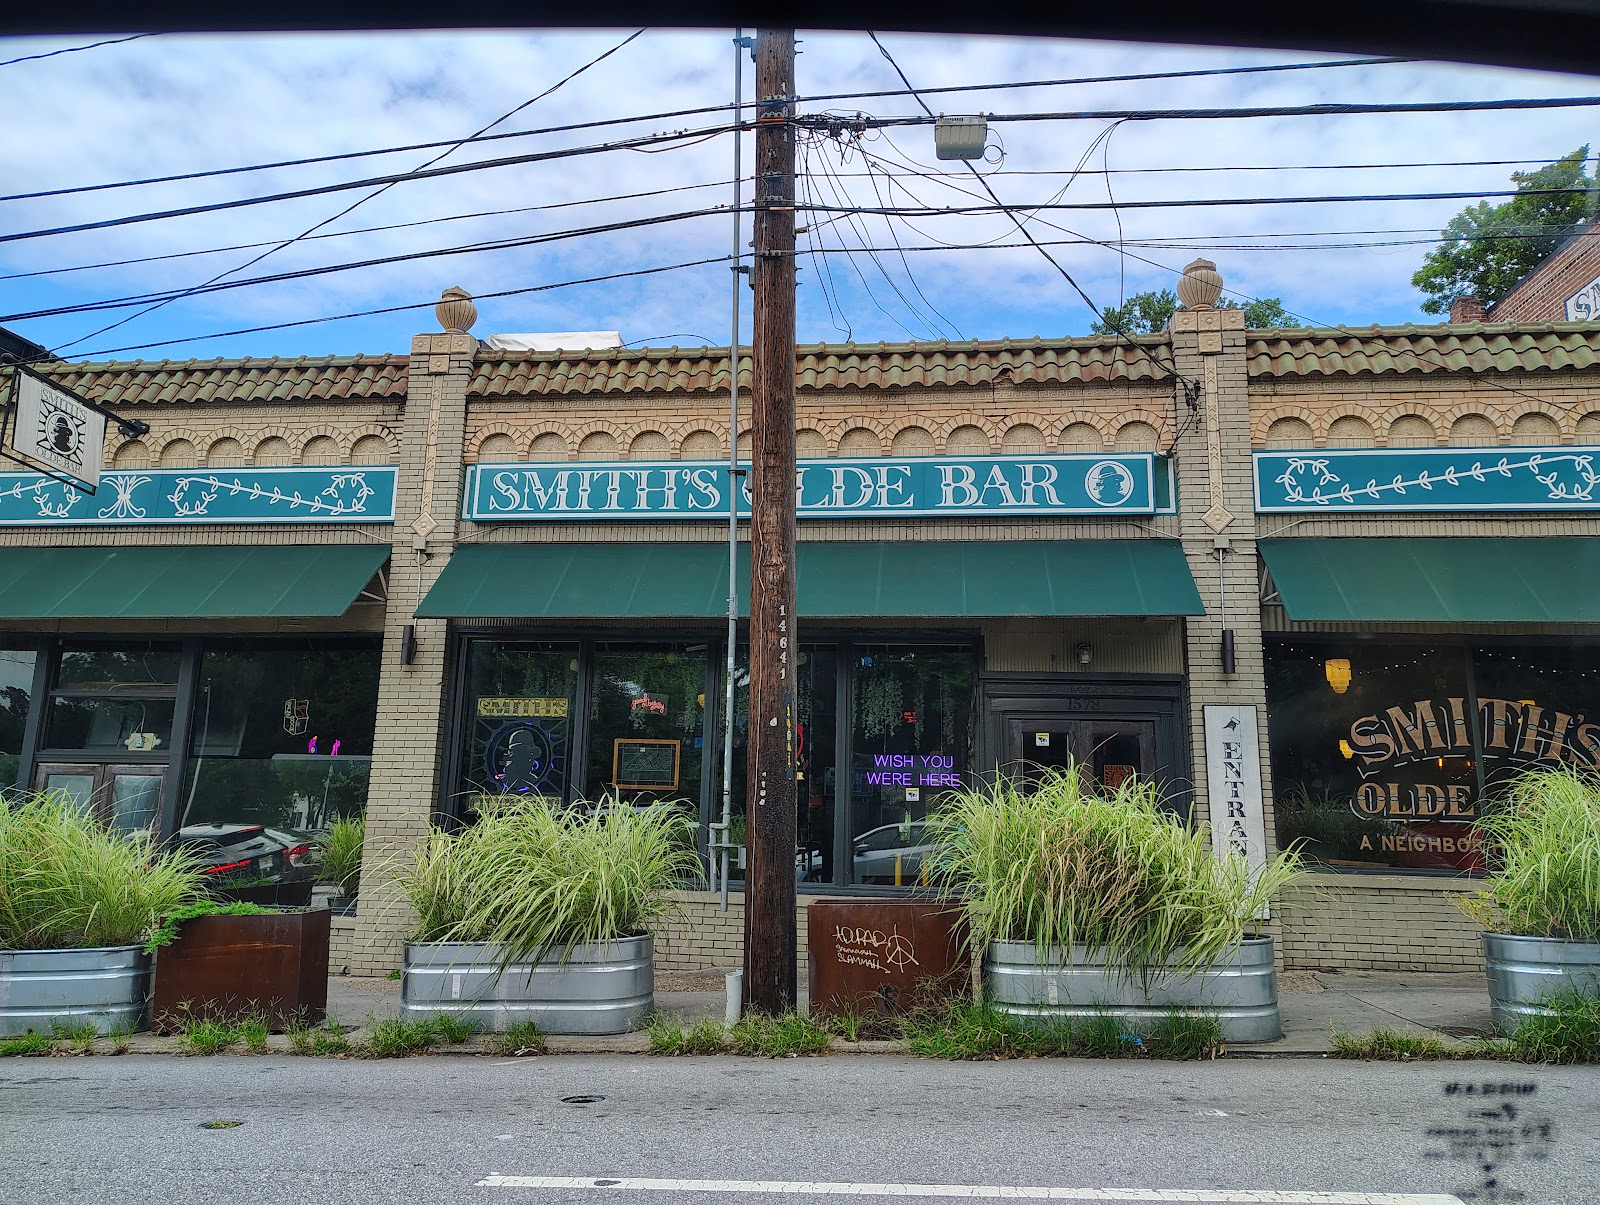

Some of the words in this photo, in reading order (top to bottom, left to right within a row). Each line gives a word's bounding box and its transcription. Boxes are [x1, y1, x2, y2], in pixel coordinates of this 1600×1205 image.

[36, 446, 63, 465] OLDE
[63, 458, 82, 475] BAR
[488, 468, 721, 511] SMITH'S
[742, 465, 914, 508] LDE
[934, 464, 1066, 507] BAR
[778, 604, 788, 680] 14641
[1066, 698, 1100, 711] 1578
[1350, 697, 1600, 770] SMITH'S
[874, 754, 914, 768] WISH
[920, 755, 954, 769] YOU
[866, 772, 913, 786] WERE
[919, 773, 960, 787] HERE
[1221, 741, 1248, 860] ENTRAN
[1354, 782, 1475, 817] OLDE
[1360, 834, 1373, 851] A
